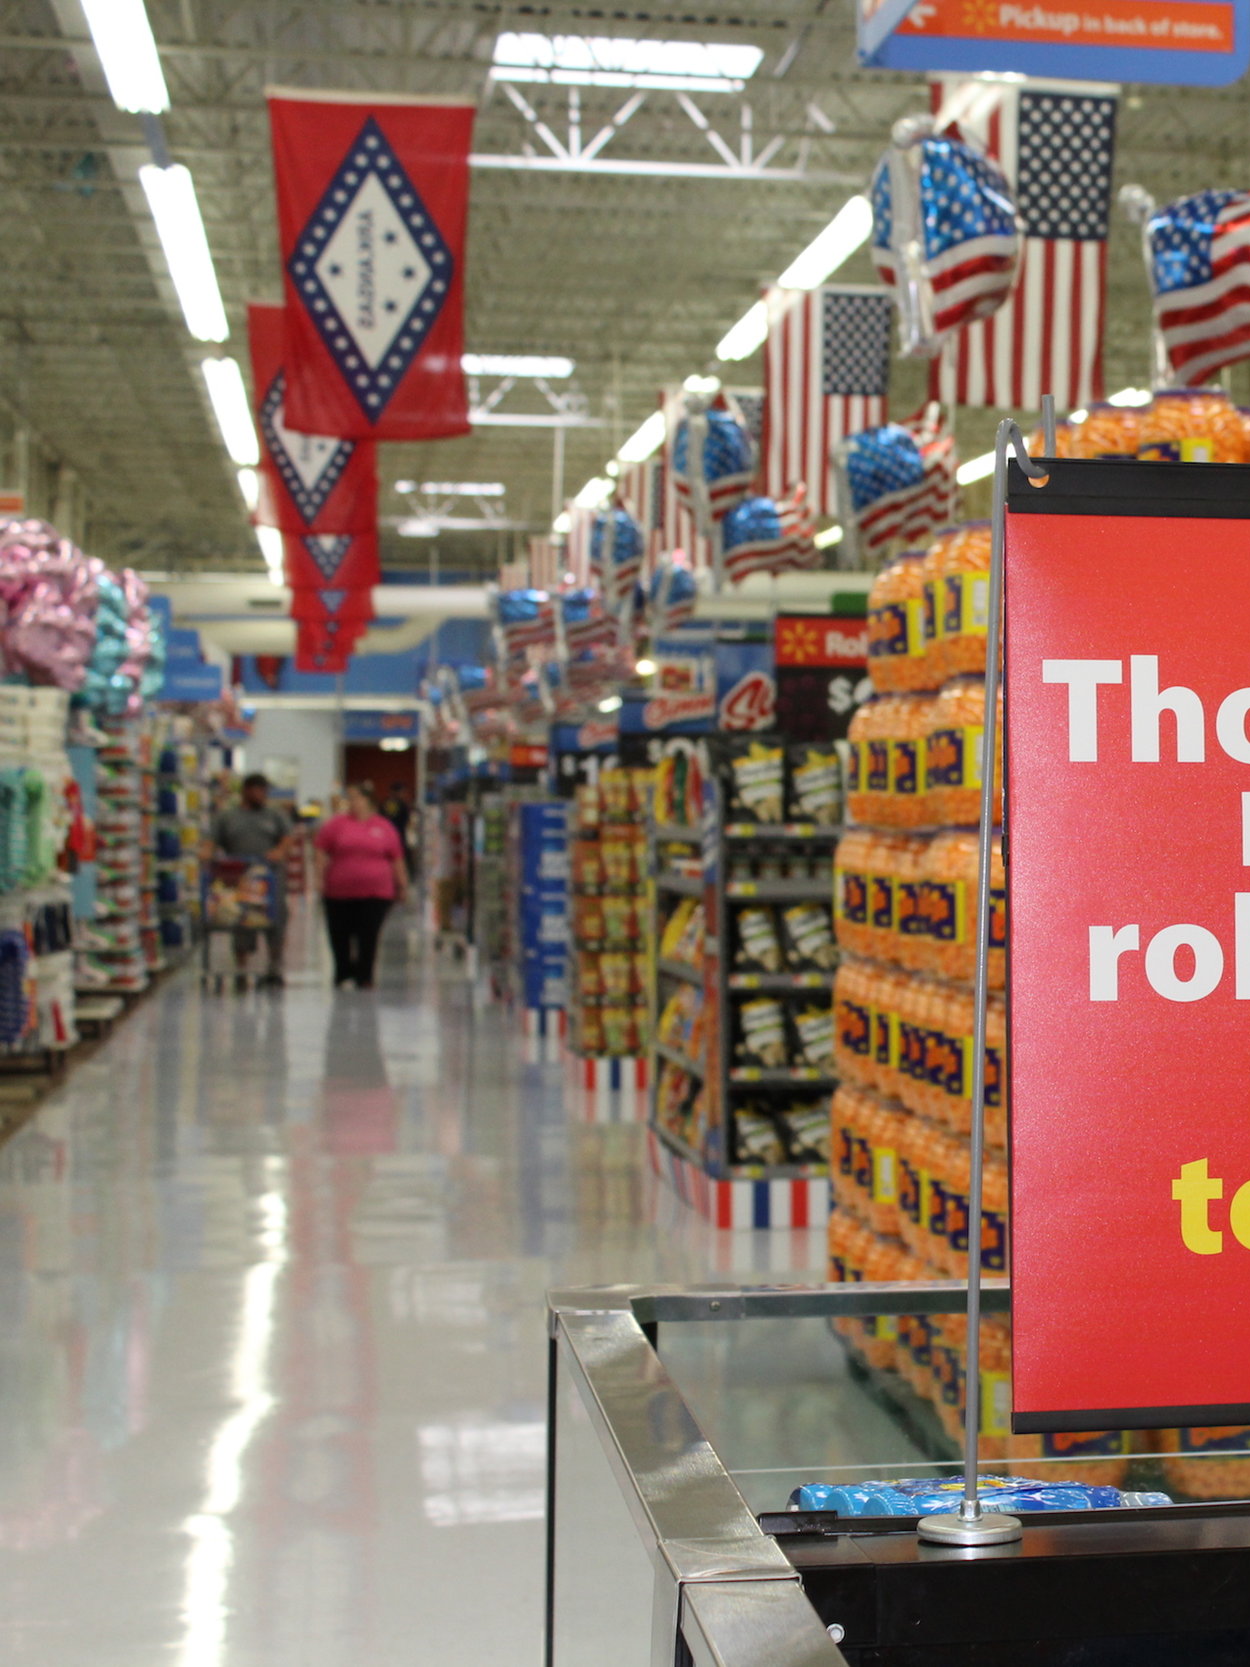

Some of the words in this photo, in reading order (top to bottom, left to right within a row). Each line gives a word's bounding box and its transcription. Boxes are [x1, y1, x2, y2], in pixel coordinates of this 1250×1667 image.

[1000, 4, 1080, 35] Pickup
[1083, 16, 1101, 31] in
[1104, 15, 1147, 35] back
[1150, 18, 1171, 36] of
[1172, 20, 1224, 39] store.
